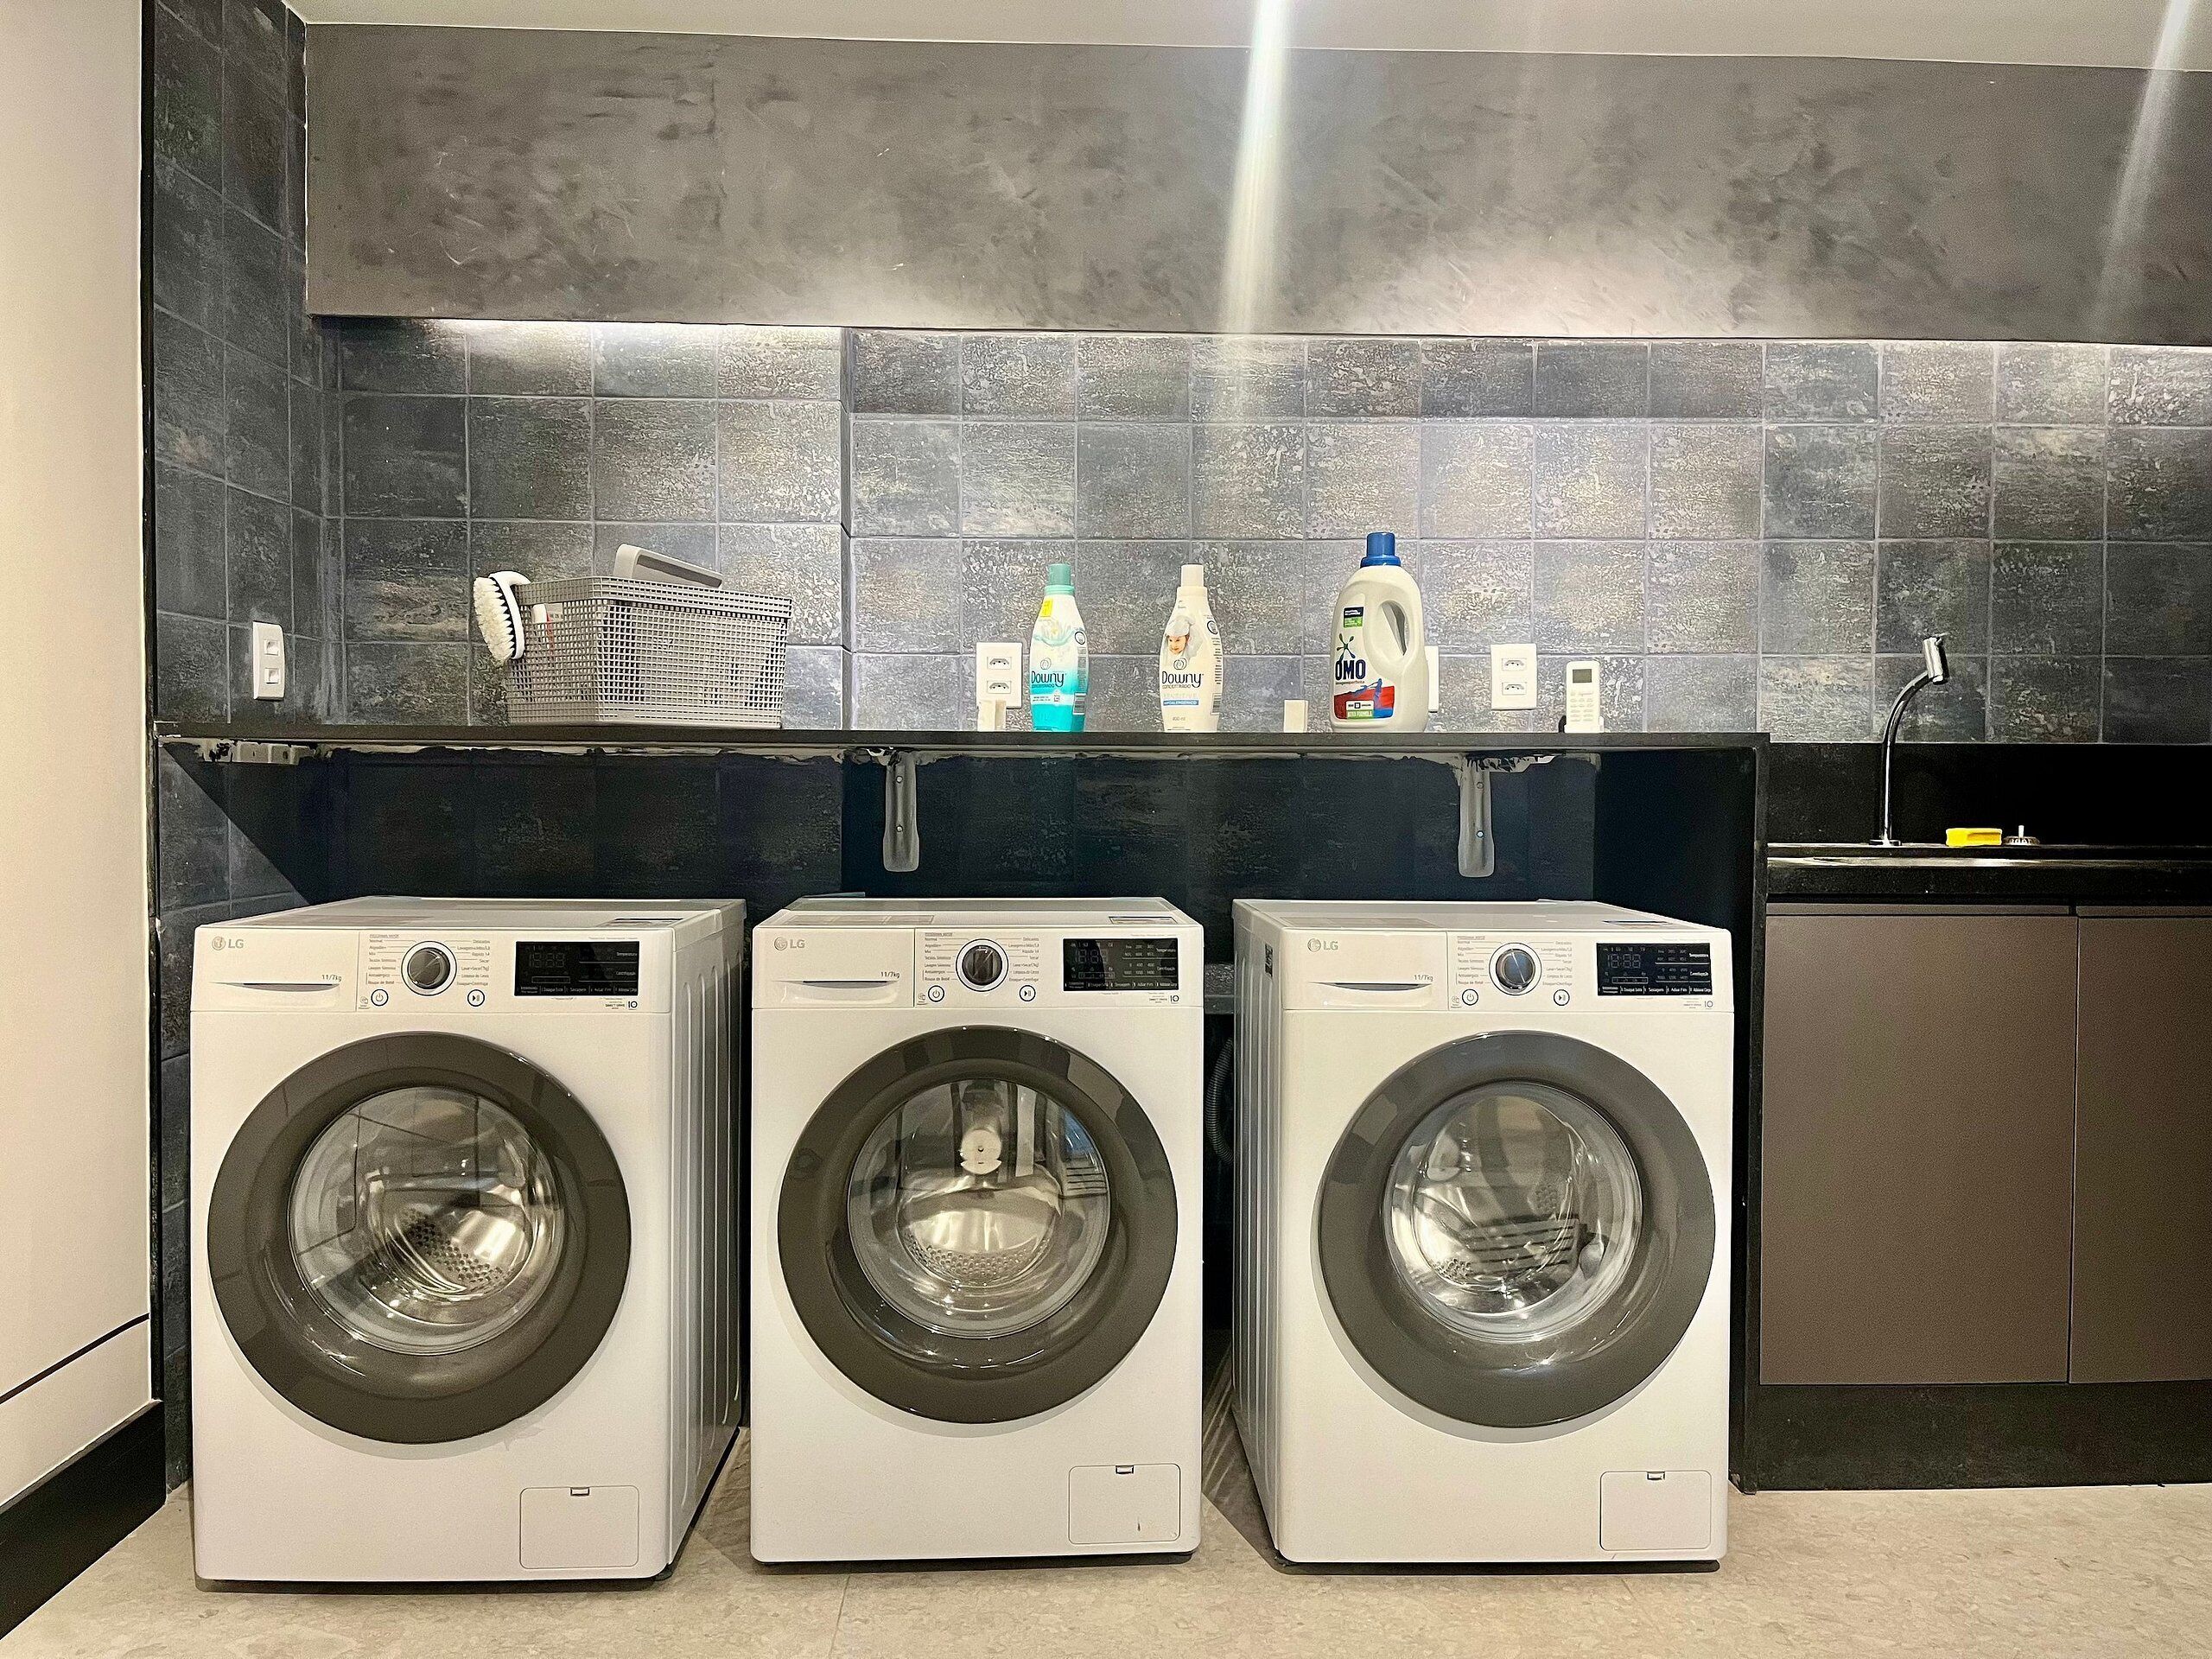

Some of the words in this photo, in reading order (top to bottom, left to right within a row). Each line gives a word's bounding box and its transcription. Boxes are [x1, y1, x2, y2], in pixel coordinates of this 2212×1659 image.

[1335, 659, 1366, 681] OMO
[1032, 671, 1065, 687] Downy
[1162, 671, 1201, 688] Downy
[228, 938, 244, 949] LG
[790, 939, 805, 949] LG
[1324, 941, 1338, 950] LG
